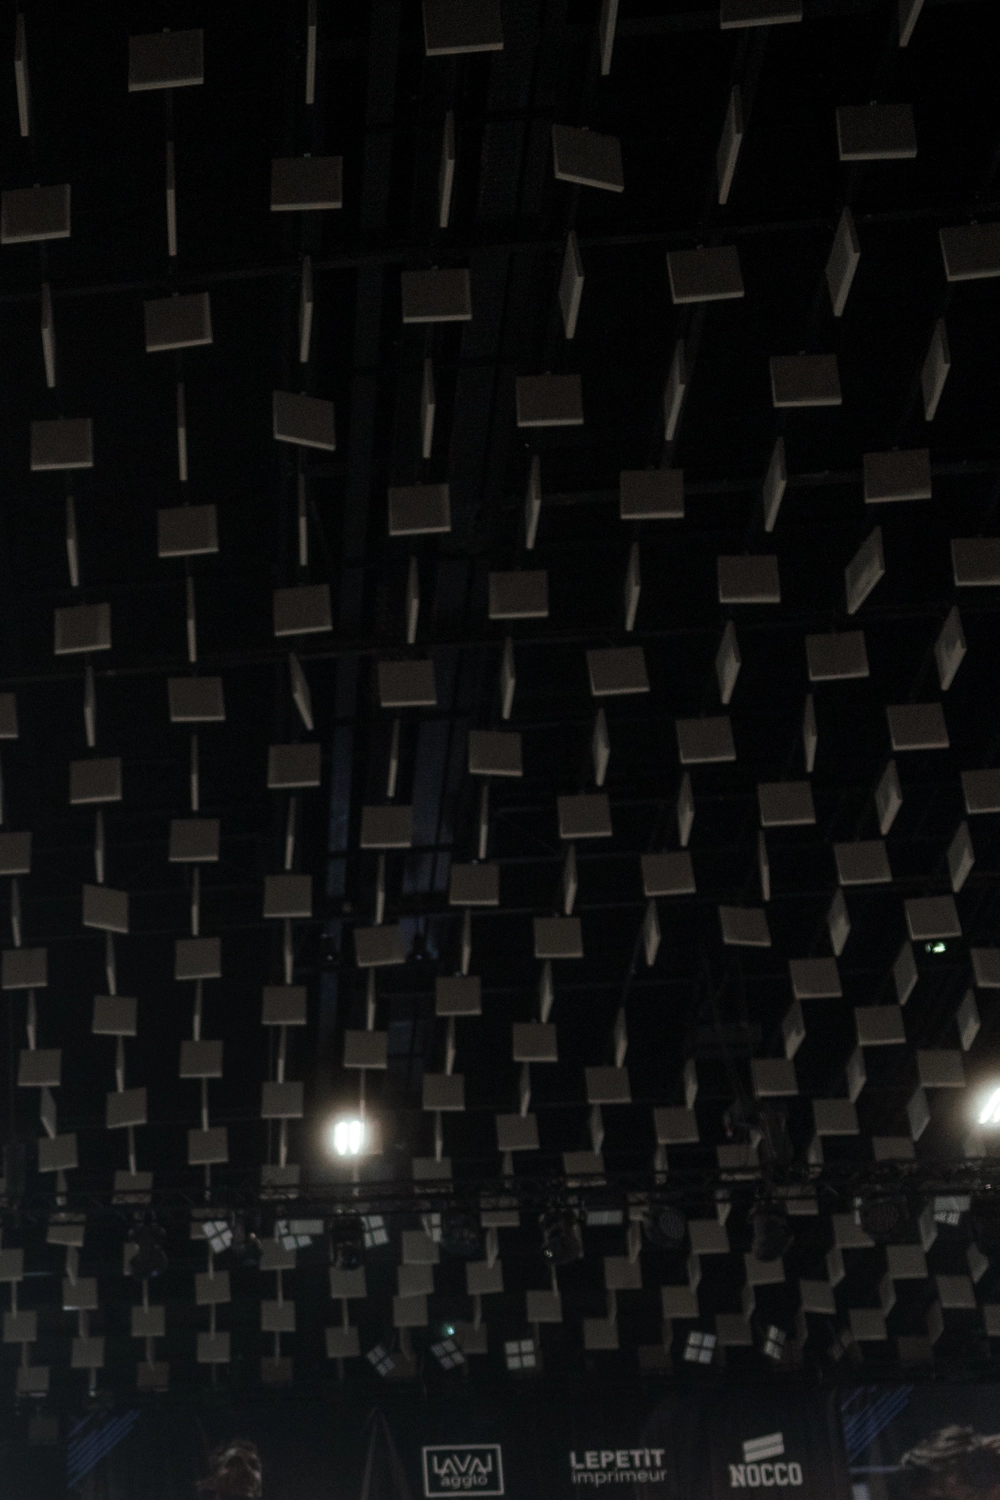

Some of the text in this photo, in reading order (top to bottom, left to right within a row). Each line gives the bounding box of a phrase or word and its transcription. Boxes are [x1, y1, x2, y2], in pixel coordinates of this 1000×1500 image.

[569, 1448, 665, 1469] LEPETIT
[441, 1473, 488, 1489] agglo
[571, 1467, 667, 1487] imprimeur
[728, 1462, 802, 1487] NOCCO
